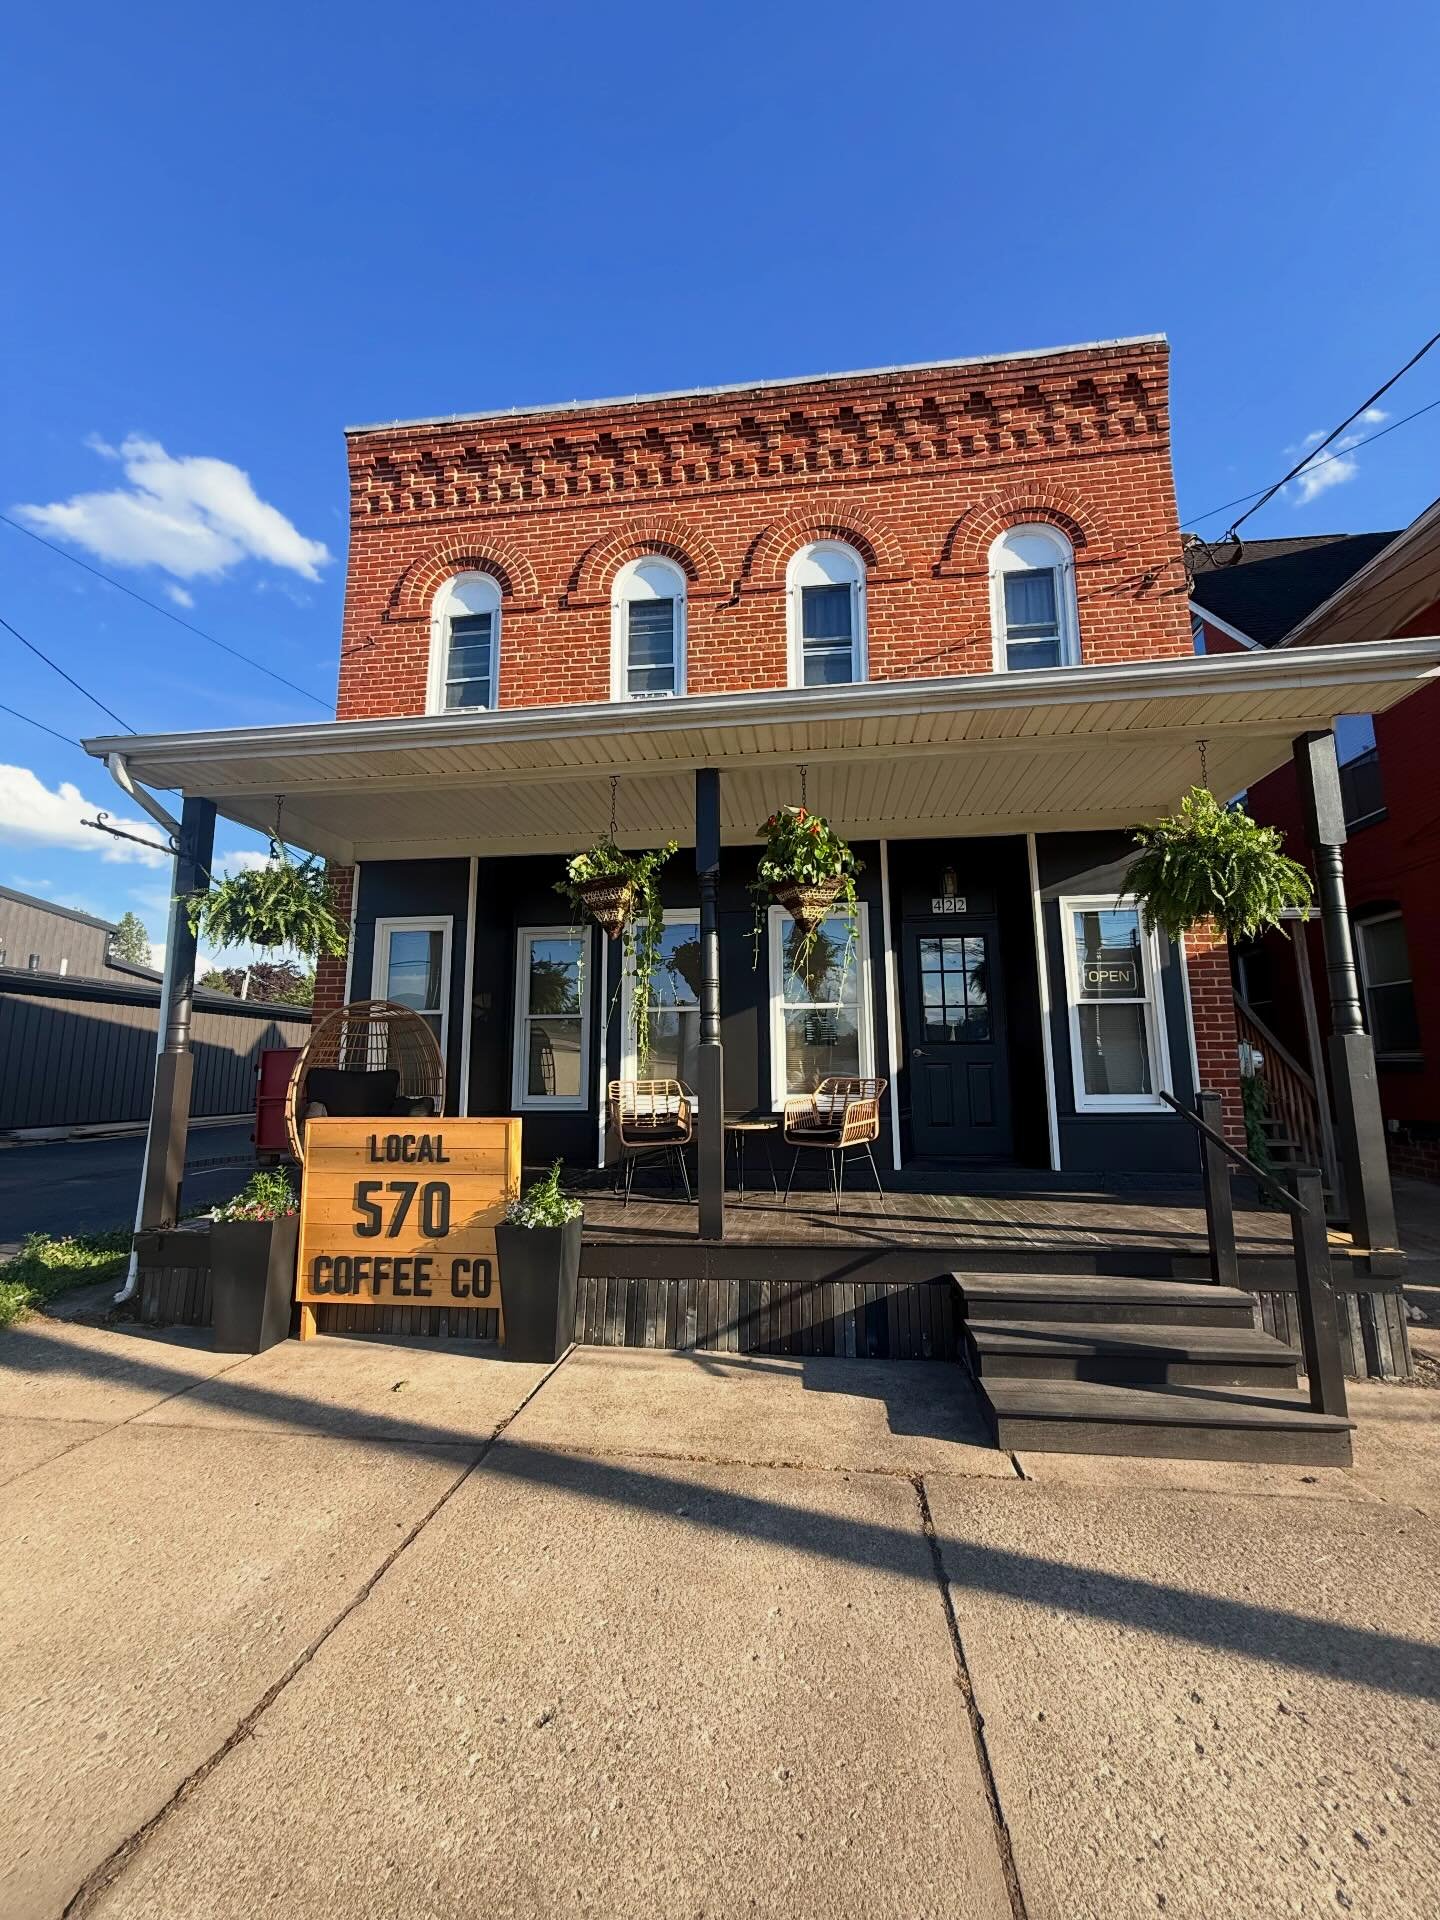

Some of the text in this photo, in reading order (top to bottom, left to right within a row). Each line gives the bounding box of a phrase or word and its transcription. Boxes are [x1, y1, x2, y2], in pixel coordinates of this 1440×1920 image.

[933, 899, 966, 912] 422
[1088, 970, 1130, 982] OPEN
[370, 1134, 450, 1162] LOCAL
[356, 1181, 450, 1238] 570
[312, 1255, 492, 1299] COFFEE CO
